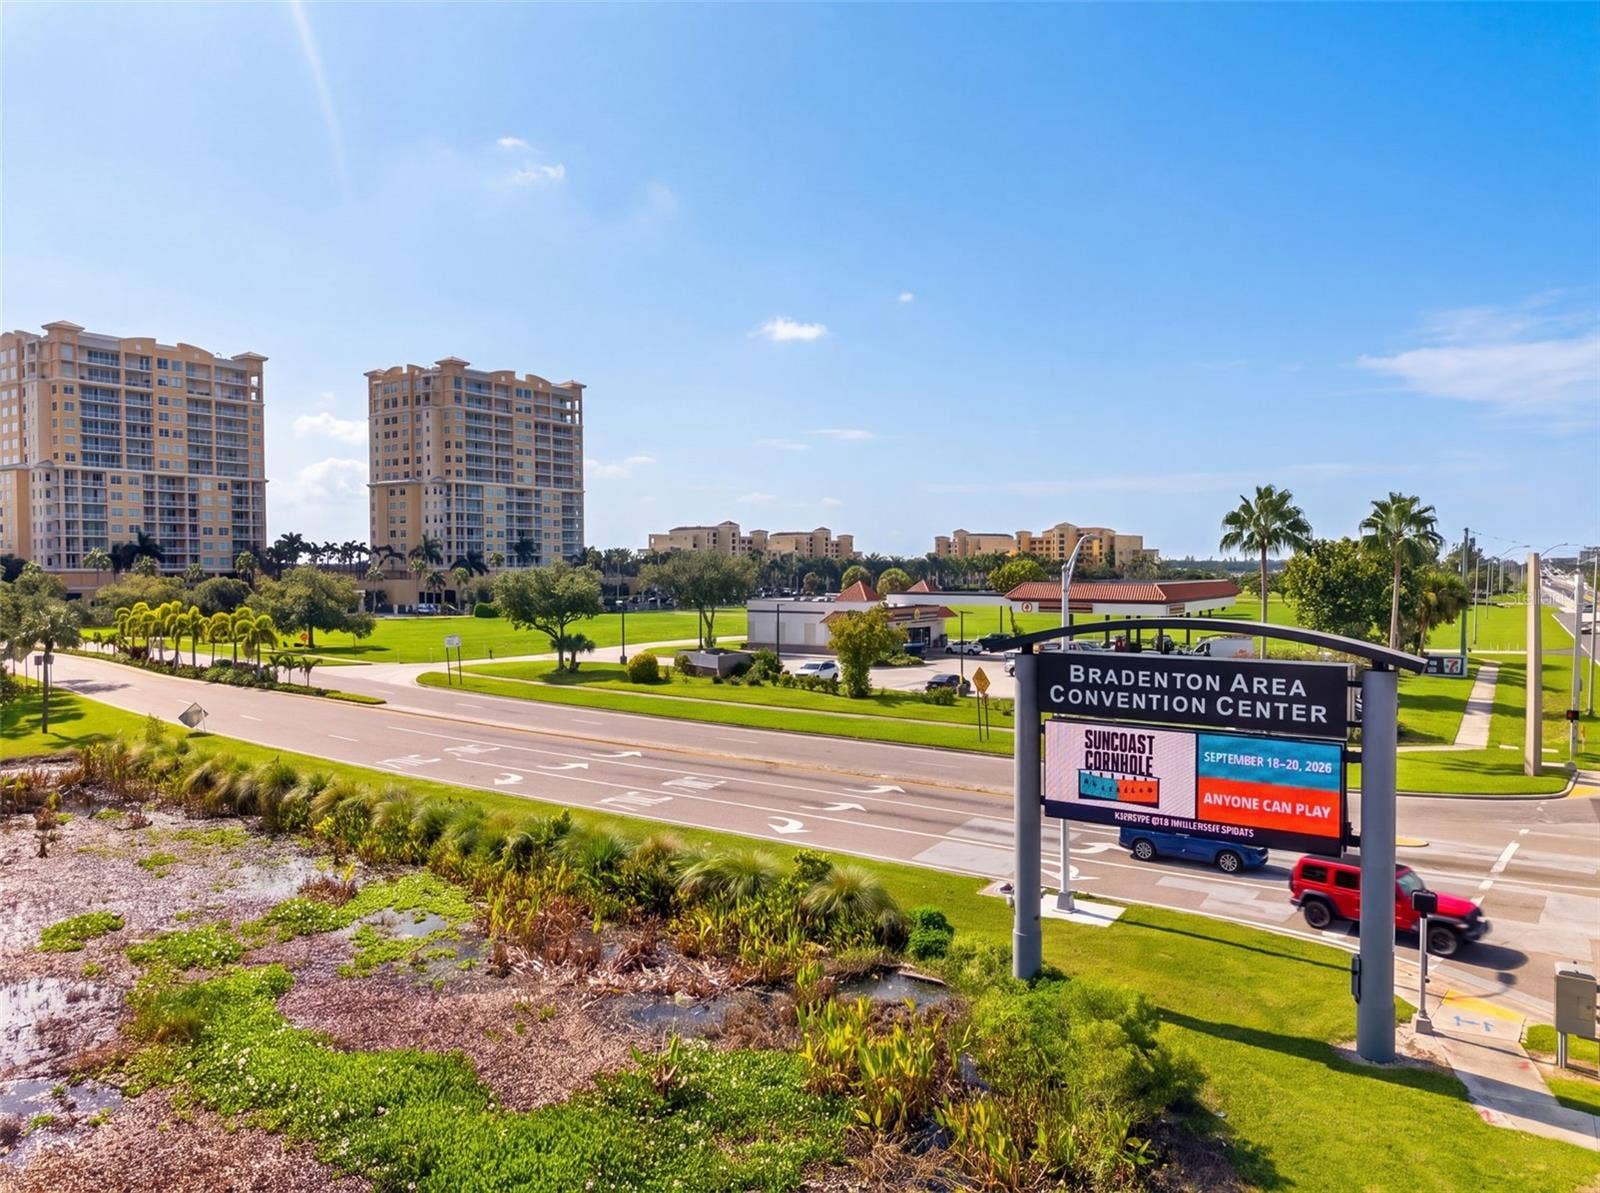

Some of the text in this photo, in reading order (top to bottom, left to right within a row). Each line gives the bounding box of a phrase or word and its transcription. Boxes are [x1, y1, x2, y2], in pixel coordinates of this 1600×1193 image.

[1070, 664, 1307, 697] BRADENTON AREA
[1050, 685, 1327, 723] CONVENTION CENTER
[1085, 729, 1155, 755] SUNCOAST
[1085, 750, 1153, 777] CORNHOLE
[1204, 751, 1264, 767] SEPTEMBER
[1305, 760, 1332, 774] 2026
[1204, 792, 1331, 819] ANYONE CAN PLAY
